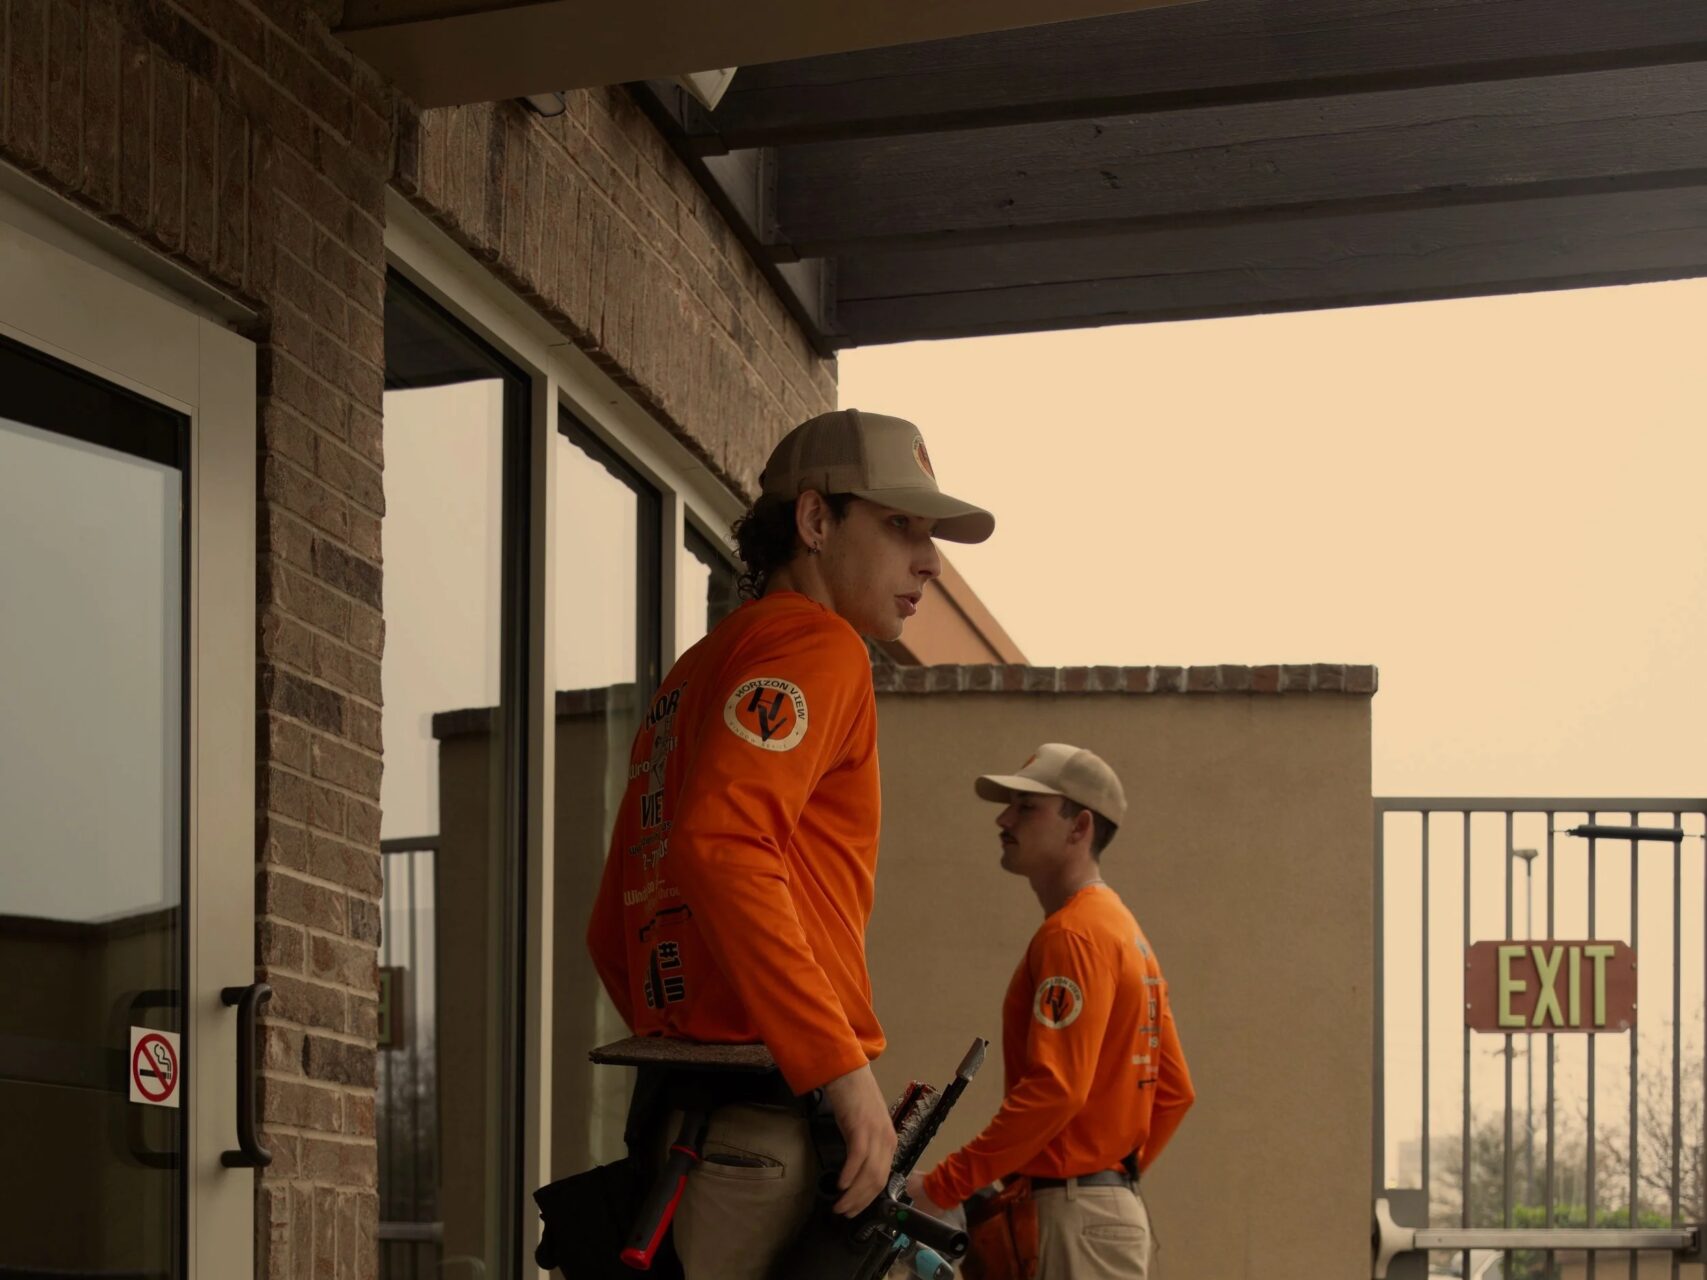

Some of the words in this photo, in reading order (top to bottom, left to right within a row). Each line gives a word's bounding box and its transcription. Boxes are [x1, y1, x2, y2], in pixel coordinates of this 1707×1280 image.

[735, 679, 789, 699] HORIZON
[789, 687, 806, 720] VIEW
[639, 786, 665, 830] VIE
[1498, 945, 1616, 1028] EXIT
